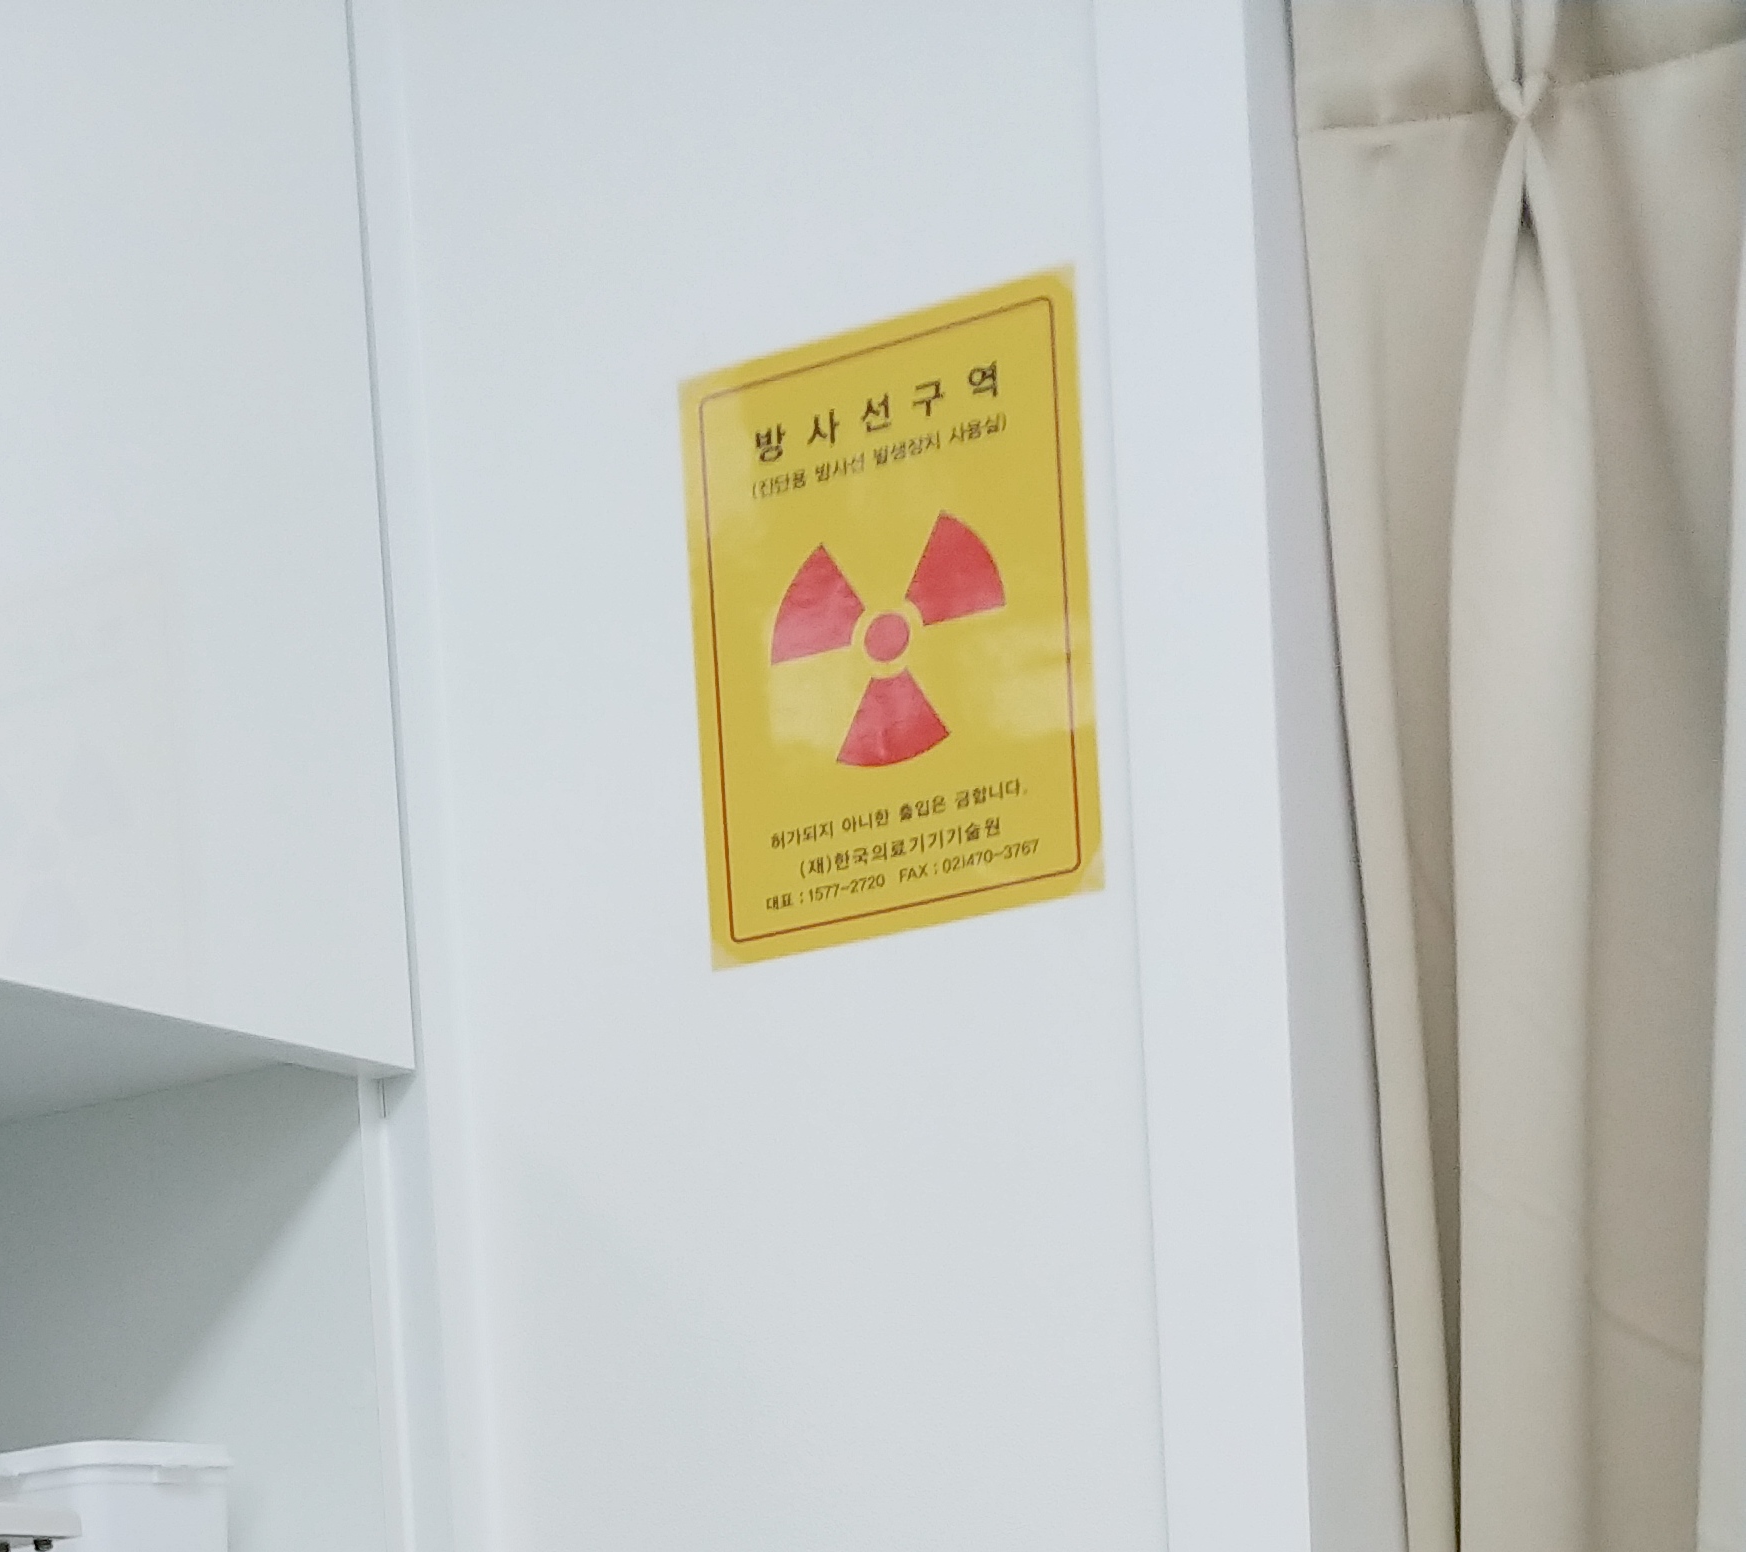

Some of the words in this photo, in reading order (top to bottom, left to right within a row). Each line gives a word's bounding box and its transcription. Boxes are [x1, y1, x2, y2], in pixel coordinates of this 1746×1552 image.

[770, 820, 835, 849] 허가되지
[841, 808, 890, 833] 아니한
[898, 795, 946, 822] 출입은
